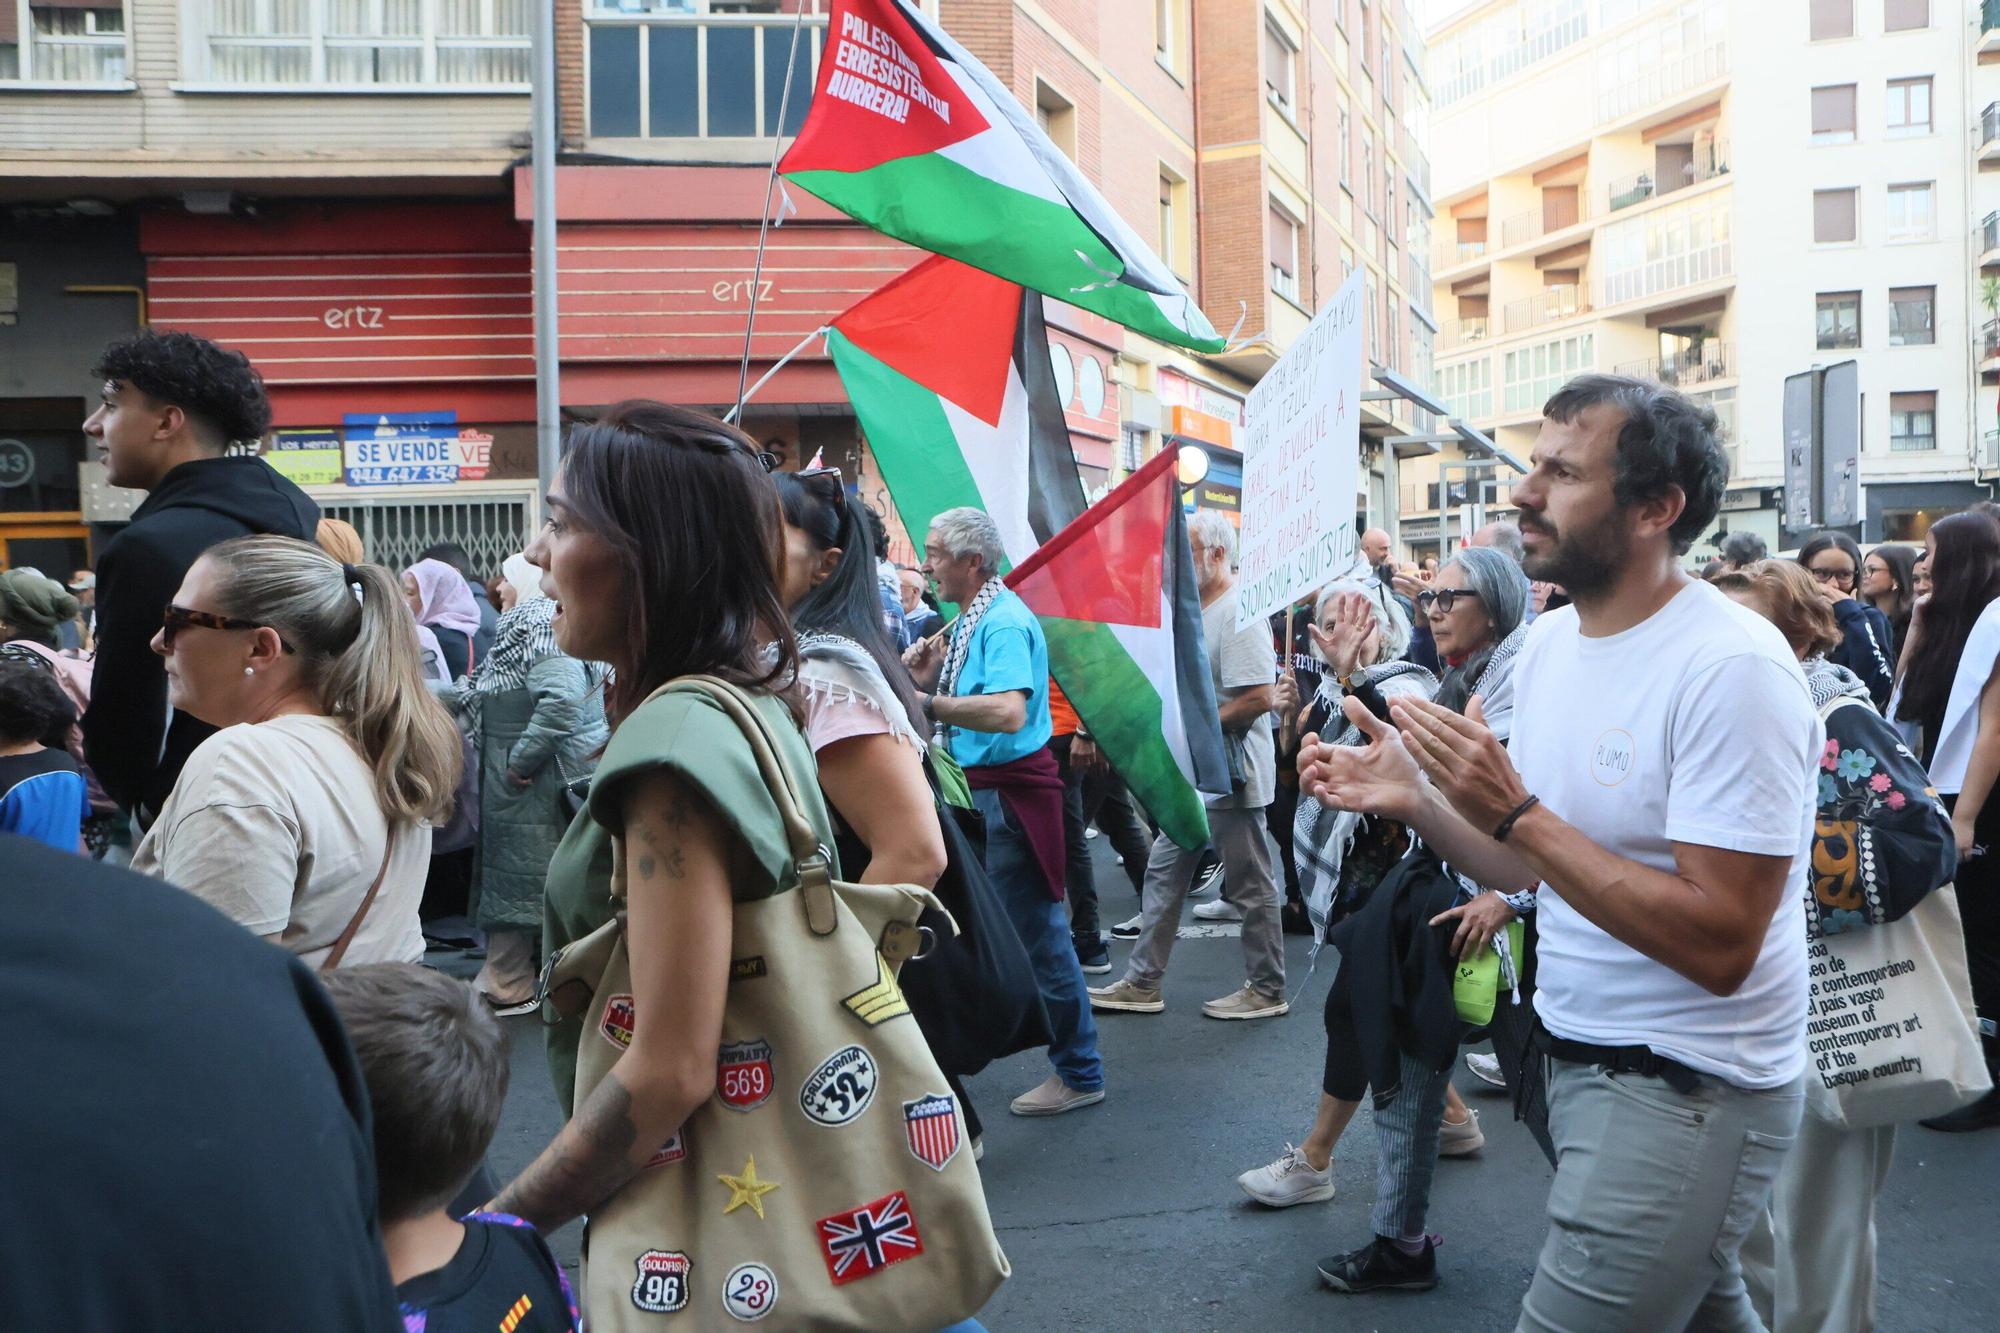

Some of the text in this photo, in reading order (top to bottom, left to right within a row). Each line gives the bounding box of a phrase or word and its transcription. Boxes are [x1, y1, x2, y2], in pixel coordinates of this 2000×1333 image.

[826, 69, 910, 124] AURRERA!
[713, 278, 774, 302] ertz
[323, 305, 384, 329] ertz
[1279, 404, 1328, 476] DEVUELVE
[1335, 388, 1345, 427] A
[358, 443, 381, 463] SE
[350, 467, 382, 482] 944
[387, 466, 421, 482] 647
[425, 465, 458, 481] 354
[1241, 461, 1316, 546] PALESTINA LAS
[1240, 518, 1356, 622] SIONISMOA SUNTSITU
[1596, 744, 1630, 772] PLUMO
[1822, 959, 1916, 994] contemporáneo
[1829, 955, 1846, 973] de
[1820, 992, 1848, 1016] país
[1848, 986, 1885, 1007] vasco
[1862, 1003, 1877, 1023] of
[1809, 1012, 1923, 1054] contemporary art
[1816, 1048, 1857, 1071] of the
[1821, 1055, 1923, 1090] basque country
[724, 1066, 765, 1097] 569
[803, 1049, 861, 1107] CALIFORNIA
[821, 1071, 869, 1116] 32
[644, 1259, 686, 1273] GOLDFISH
[645, 1275, 679, 1305] 96
[731, 1272, 770, 1310] 23
